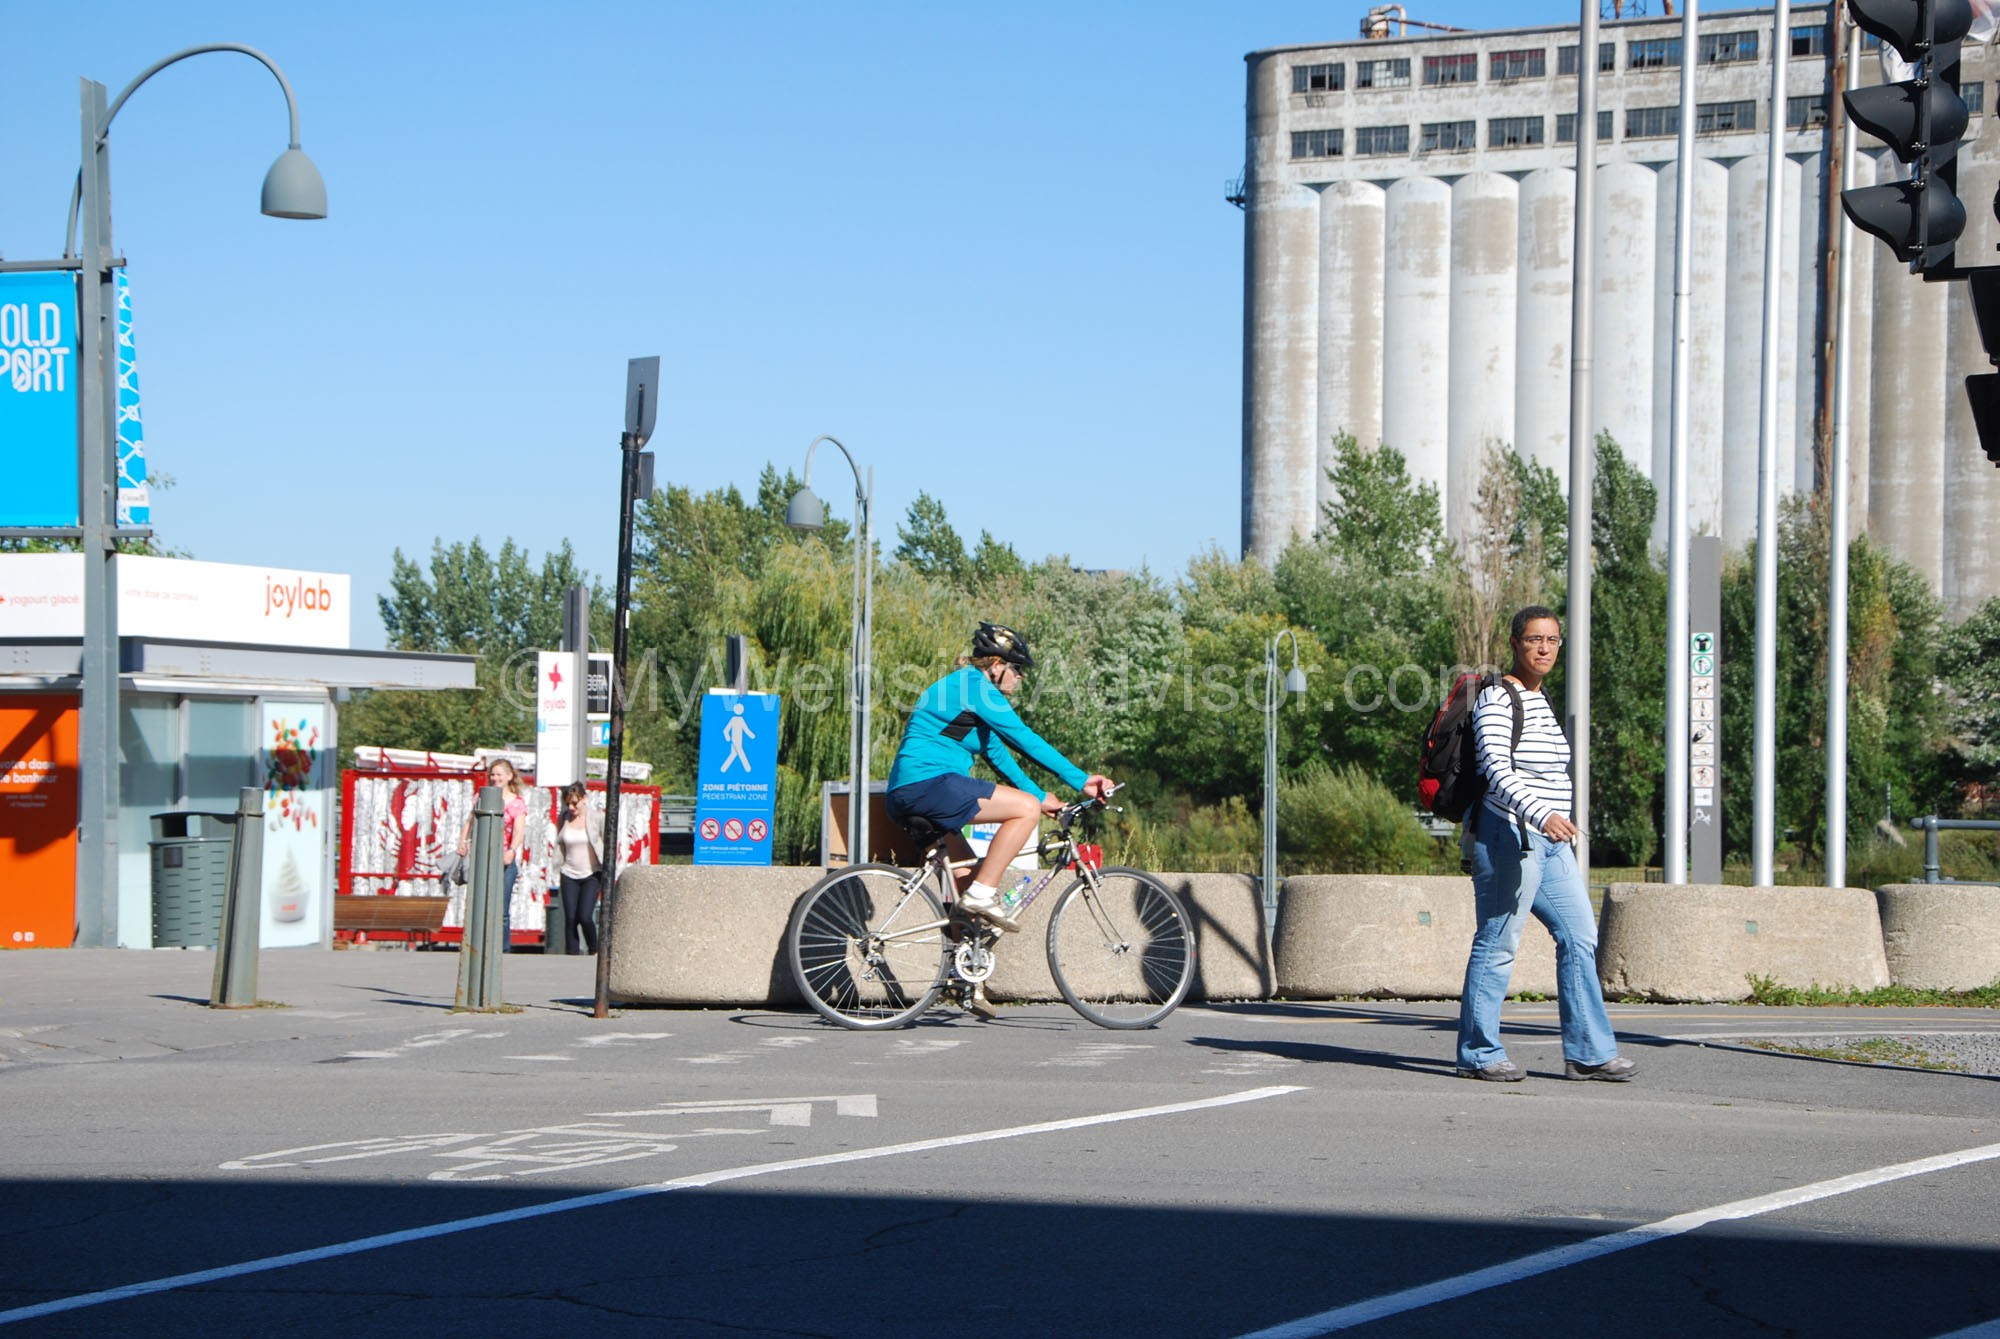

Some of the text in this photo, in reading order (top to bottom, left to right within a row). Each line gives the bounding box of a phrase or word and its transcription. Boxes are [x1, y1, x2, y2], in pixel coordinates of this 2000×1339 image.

[1, 302, 60, 348] OLD
[264, 575, 332, 618] joylab
[702, 782, 769, 792] ZONE PIÉTONNE
[702, 793, 768, 801] PEDESTRIAN ZONE
